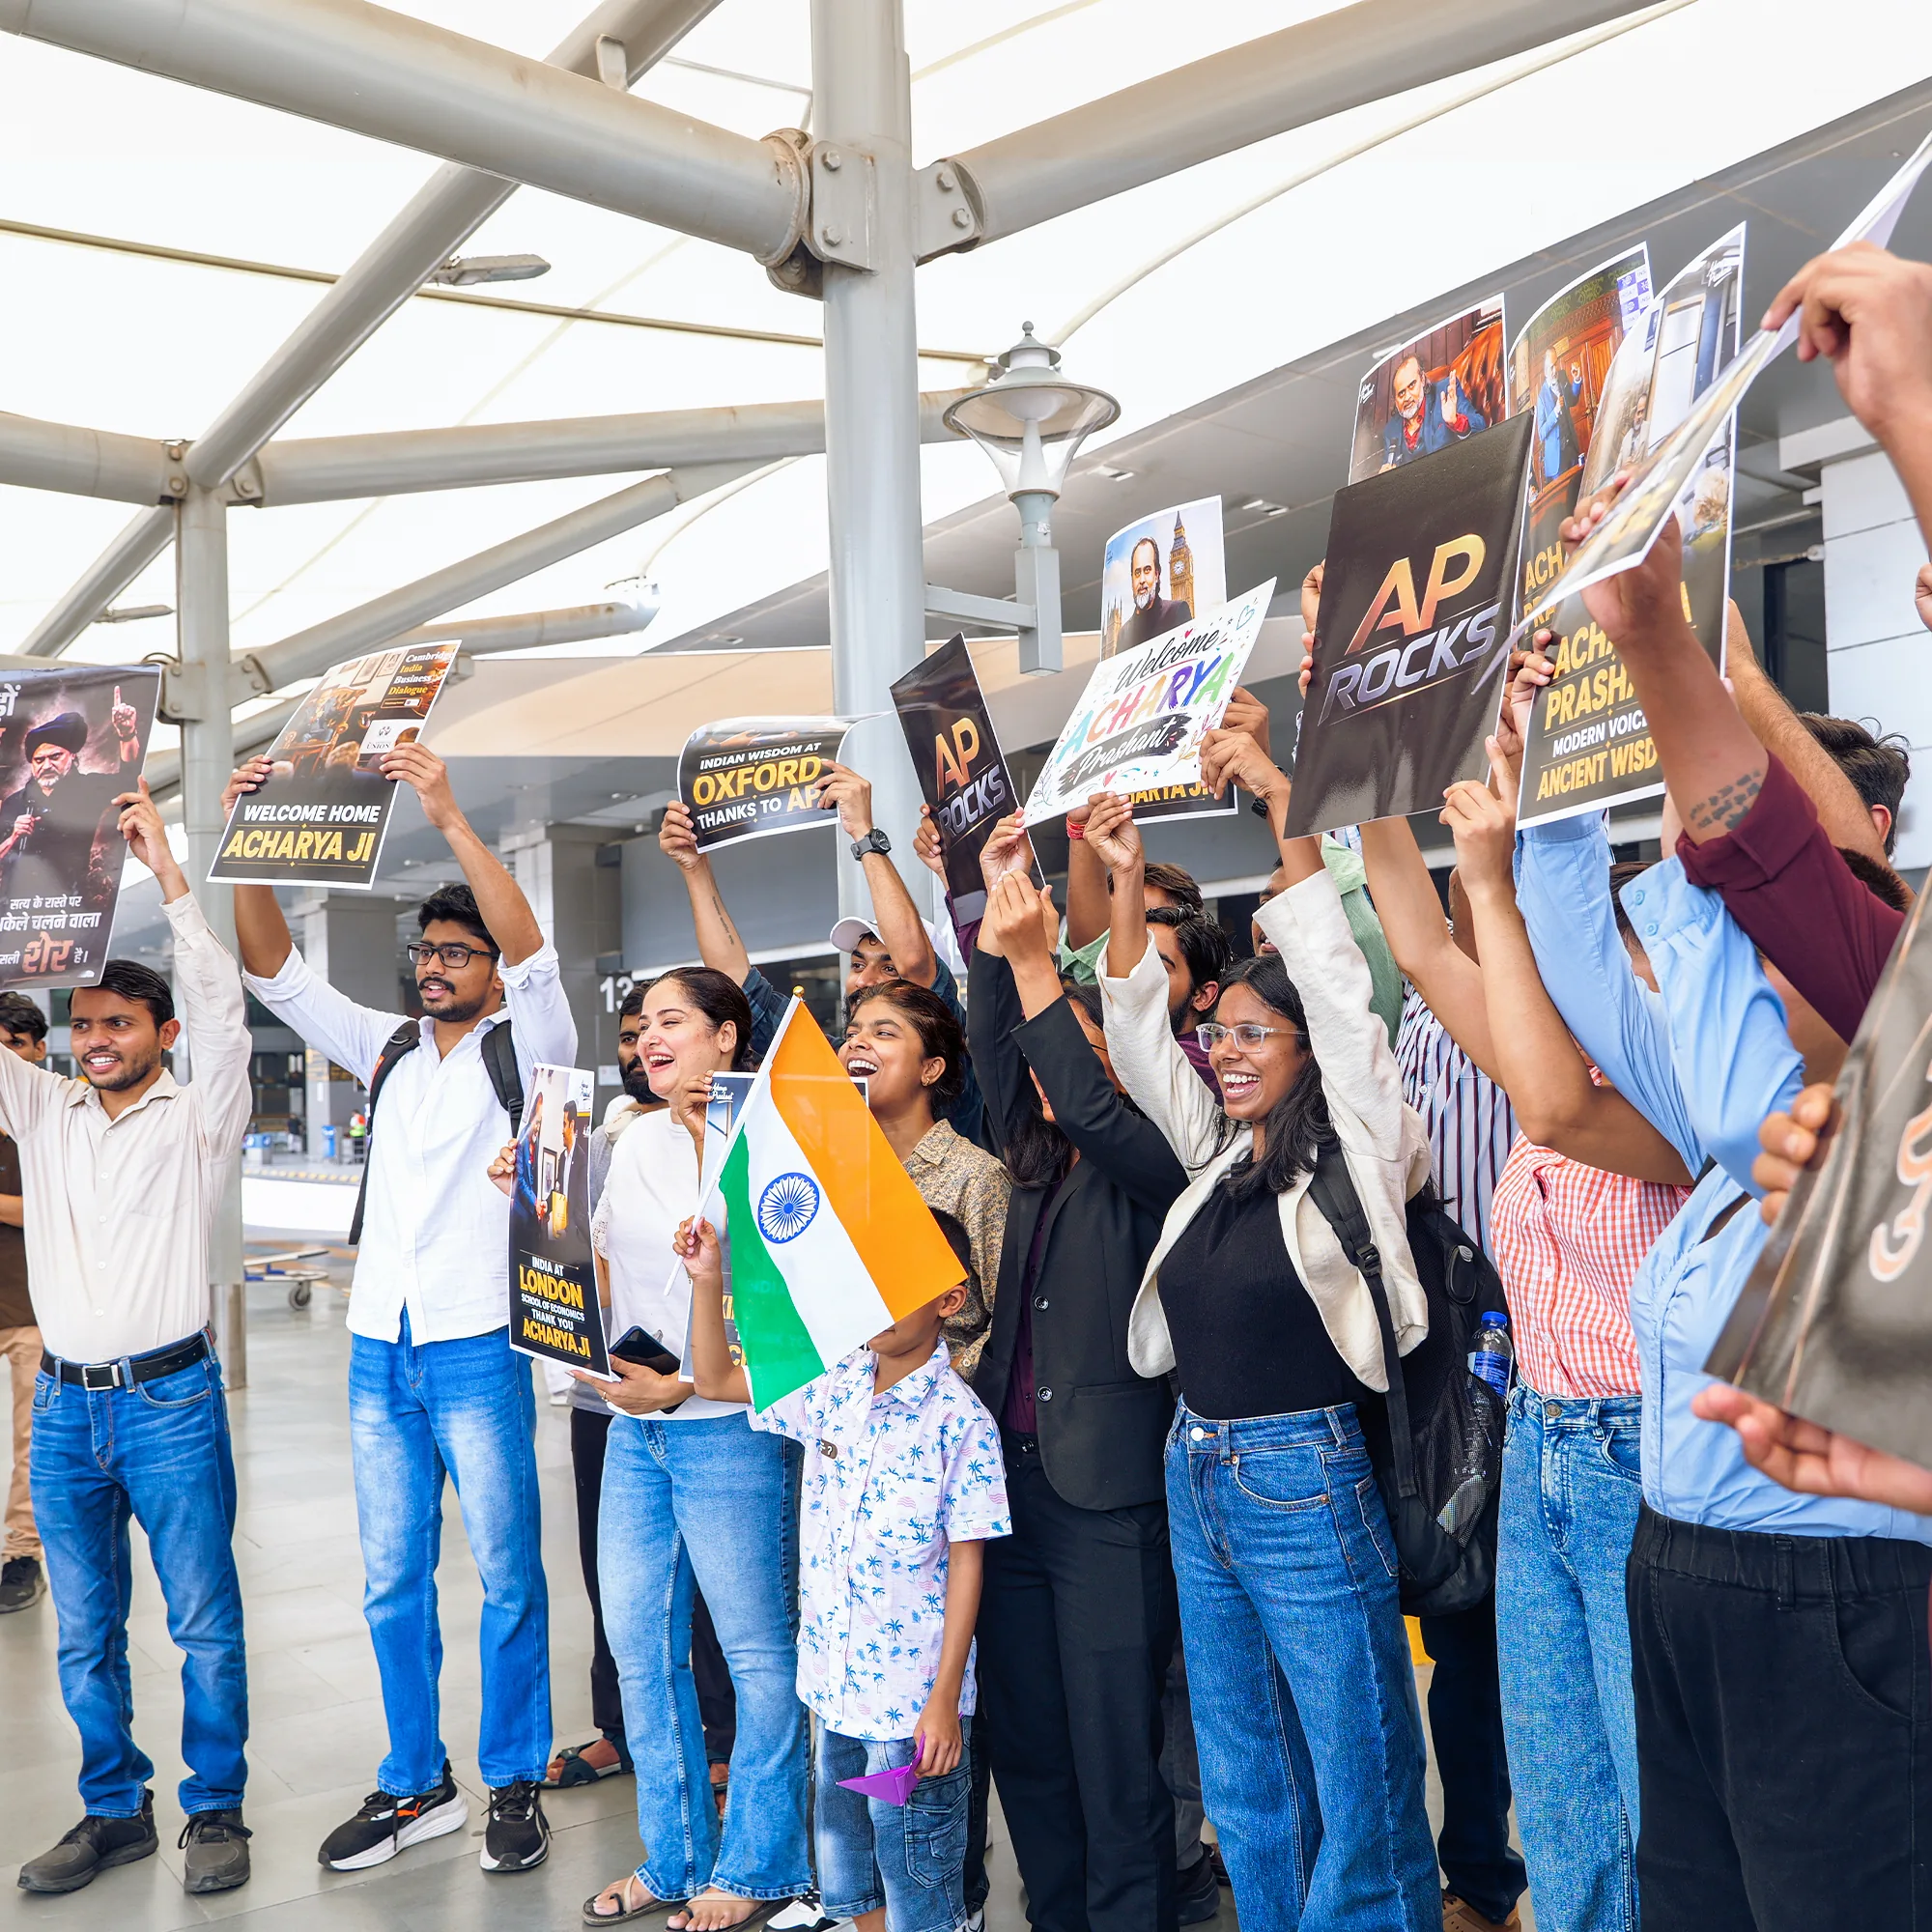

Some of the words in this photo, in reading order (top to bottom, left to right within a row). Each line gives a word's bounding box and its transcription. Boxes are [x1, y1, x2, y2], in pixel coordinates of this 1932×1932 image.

[1344, 533, 1487, 656] AP
[393, 674, 433, 685] Business
[399, 664, 423, 673] India
[1113, 629, 1220, 695] Welcome
[1318, 602, 1502, 727] ROCKS
[387, 686, 428, 696] Dialogue
[1056, 652, 1236, 764] ACHARYA
[699, 753, 746, 770] INDIAN
[748, 745, 802, 761] WISDOM
[804, 742, 822, 752] AT
[935, 717, 980, 801] AP
[1073, 715, 1178, 784] Prashant
[1552, 721, 1605, 758] MODERN
[693, 755, 823, 806] OXFORD
[1536, 750, 1608, 802] ANCIENT
[243, 804, 327, 822] WELCOME
[327, 805, 382, 823] HOME
[696, 802, 756, 830] THANKS
[760, 798, 782, 814] TO
[786, 787, 822, 812] AP
[938, 764, 1006, 840] ROCKS
[221, 830, 343, 861] ACHARYA
[346, 833, 377, 862] JI
[10, 898, 31, 910] सत्य
[33, 895, 43, 908] के
[44, 894, 69, 908] रास्ते
[69, 895, 83, 907] पर
[32, 909, 68, 929] चलने
[69, 912, 102, 928] वाला
[531, 1256, 554, 1274] INDIA
[554, 1264, 564, 1276] AT
[519, 1264, 584, 1309] LONDON
[521, 1293, 542, 1309] SCHOOL
[542, 1301, 551, 1311] OF
[550, 1303, 585, 1321] ECONOMICS
[531, 1308, 556, 1326] THANK
[557, 1317, 575, 1331] YOU
[523, 1317, 579, 1354] ACHARYA
[578, 1336, 592, 1358] JI
